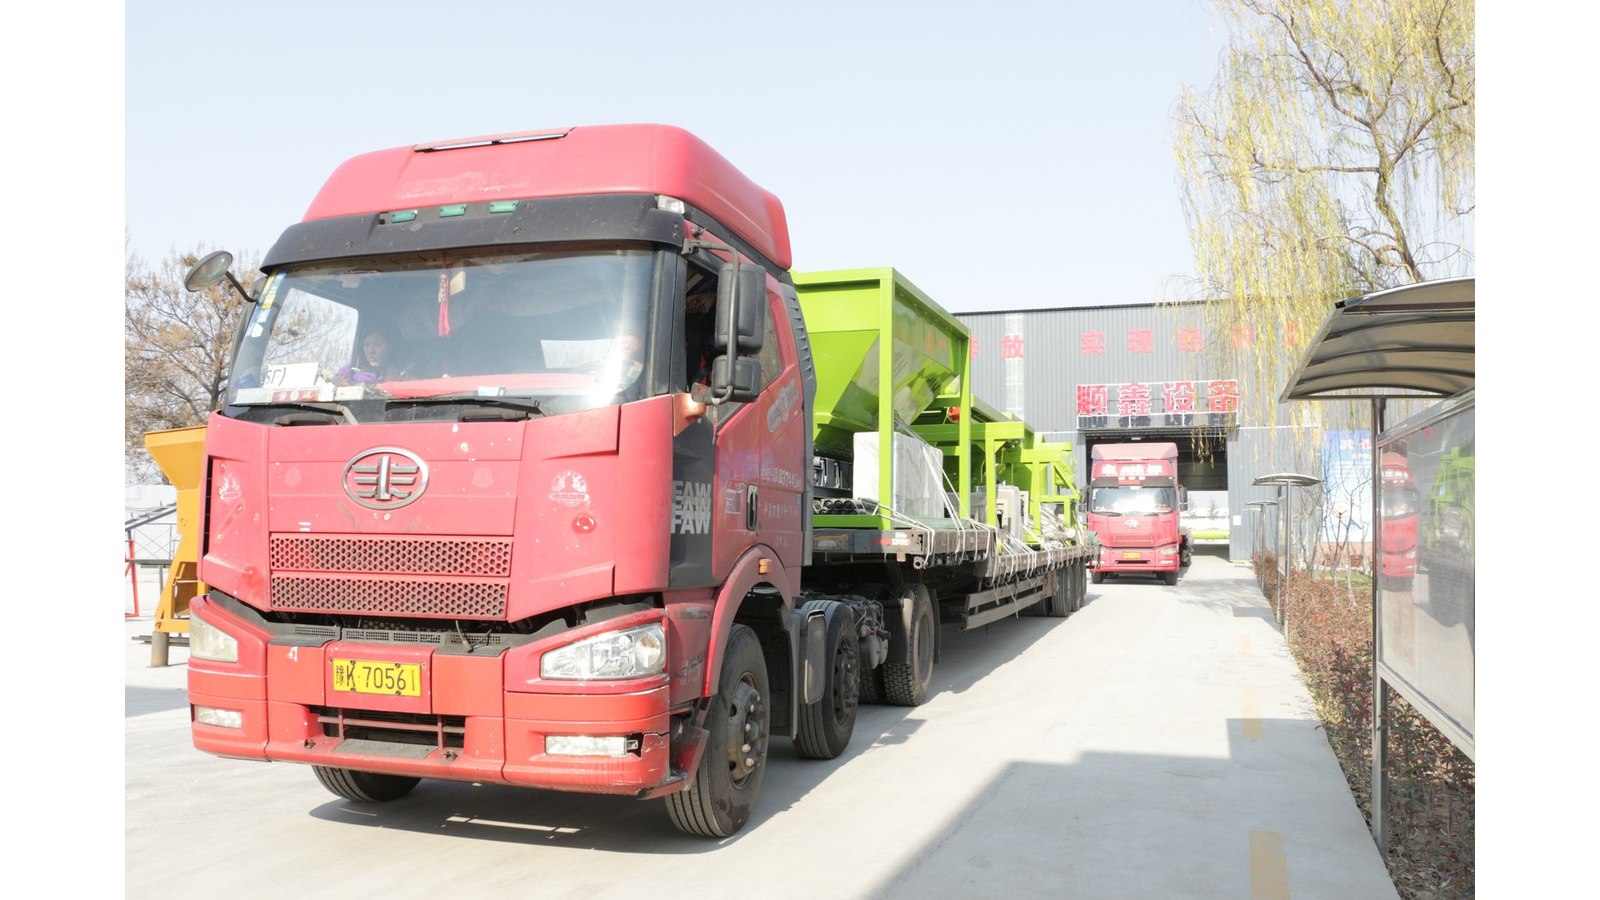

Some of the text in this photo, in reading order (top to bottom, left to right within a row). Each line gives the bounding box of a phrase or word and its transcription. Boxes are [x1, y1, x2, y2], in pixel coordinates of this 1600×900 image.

[1076, 380, 1241, 417] 顺鑫设备
[671, 510, 711, 534] FAW
